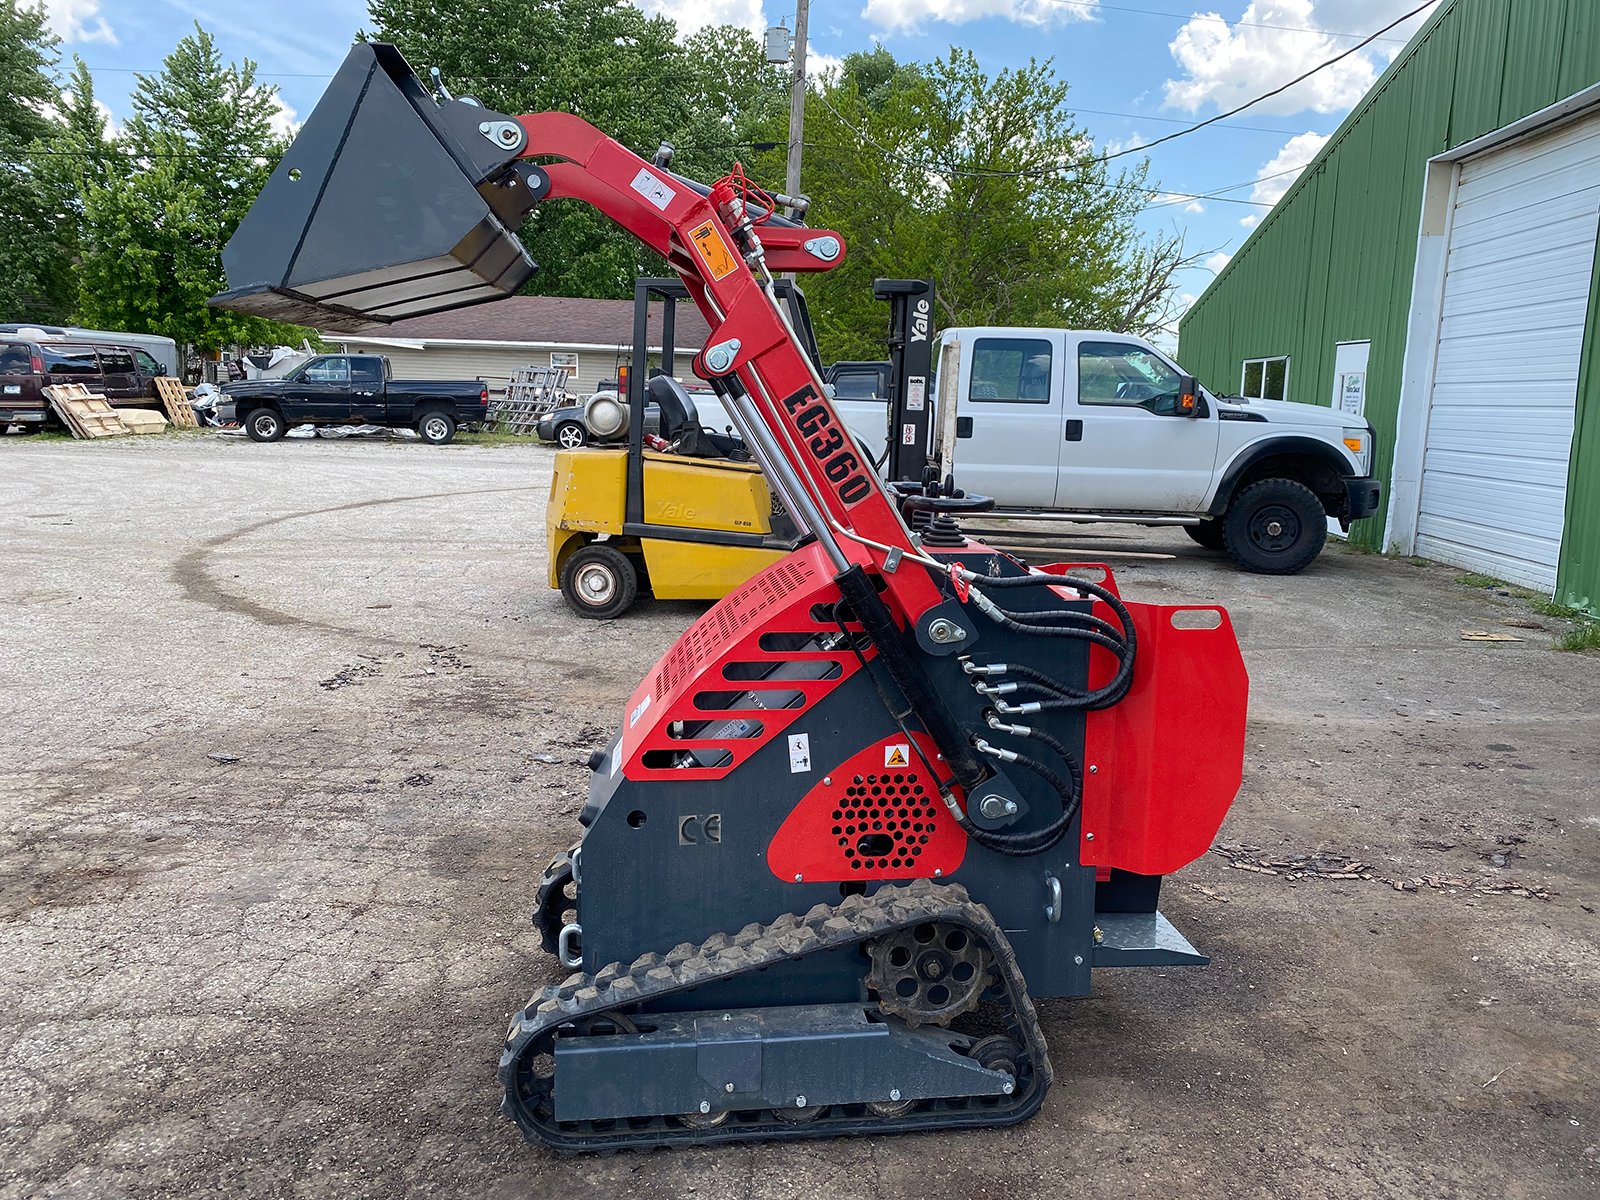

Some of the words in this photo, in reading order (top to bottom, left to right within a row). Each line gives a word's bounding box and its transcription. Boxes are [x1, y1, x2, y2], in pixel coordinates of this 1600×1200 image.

[911, 299, 930, 342] Yale
[783, 384, 871, 504] EG360
[656, 501, 697, 520] Yale
[681, 815, 720, 843] CE
